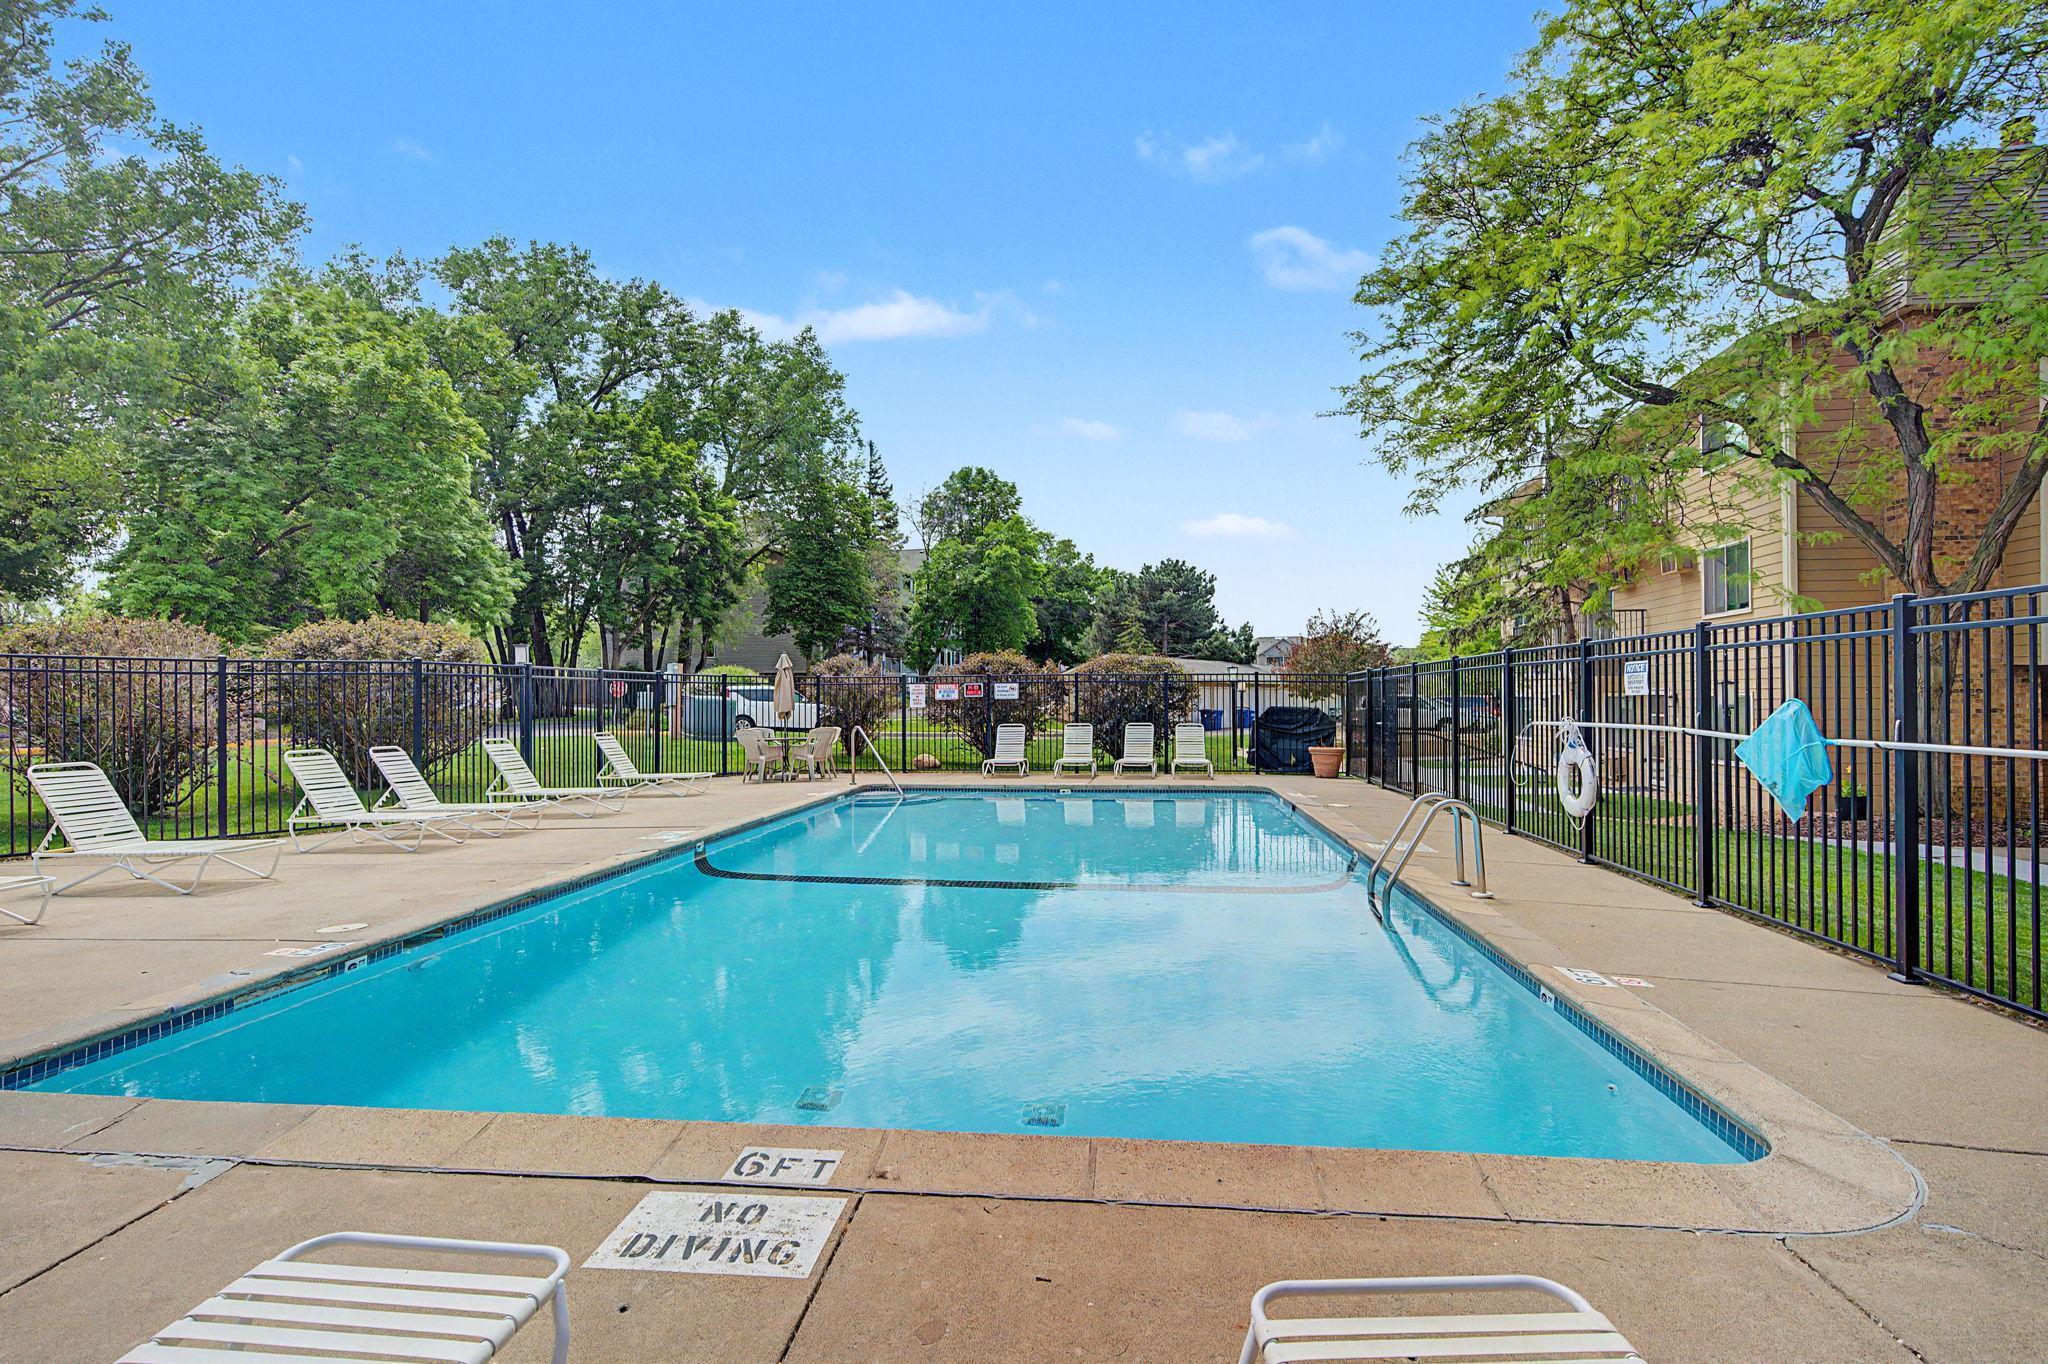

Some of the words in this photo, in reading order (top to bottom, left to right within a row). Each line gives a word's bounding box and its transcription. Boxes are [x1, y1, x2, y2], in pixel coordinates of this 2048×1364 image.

[733, 1151, 836, 1179] 6FT
[699, 1201, 769, 1225] NO
[618, 1232, 801, 1266] DIVING
